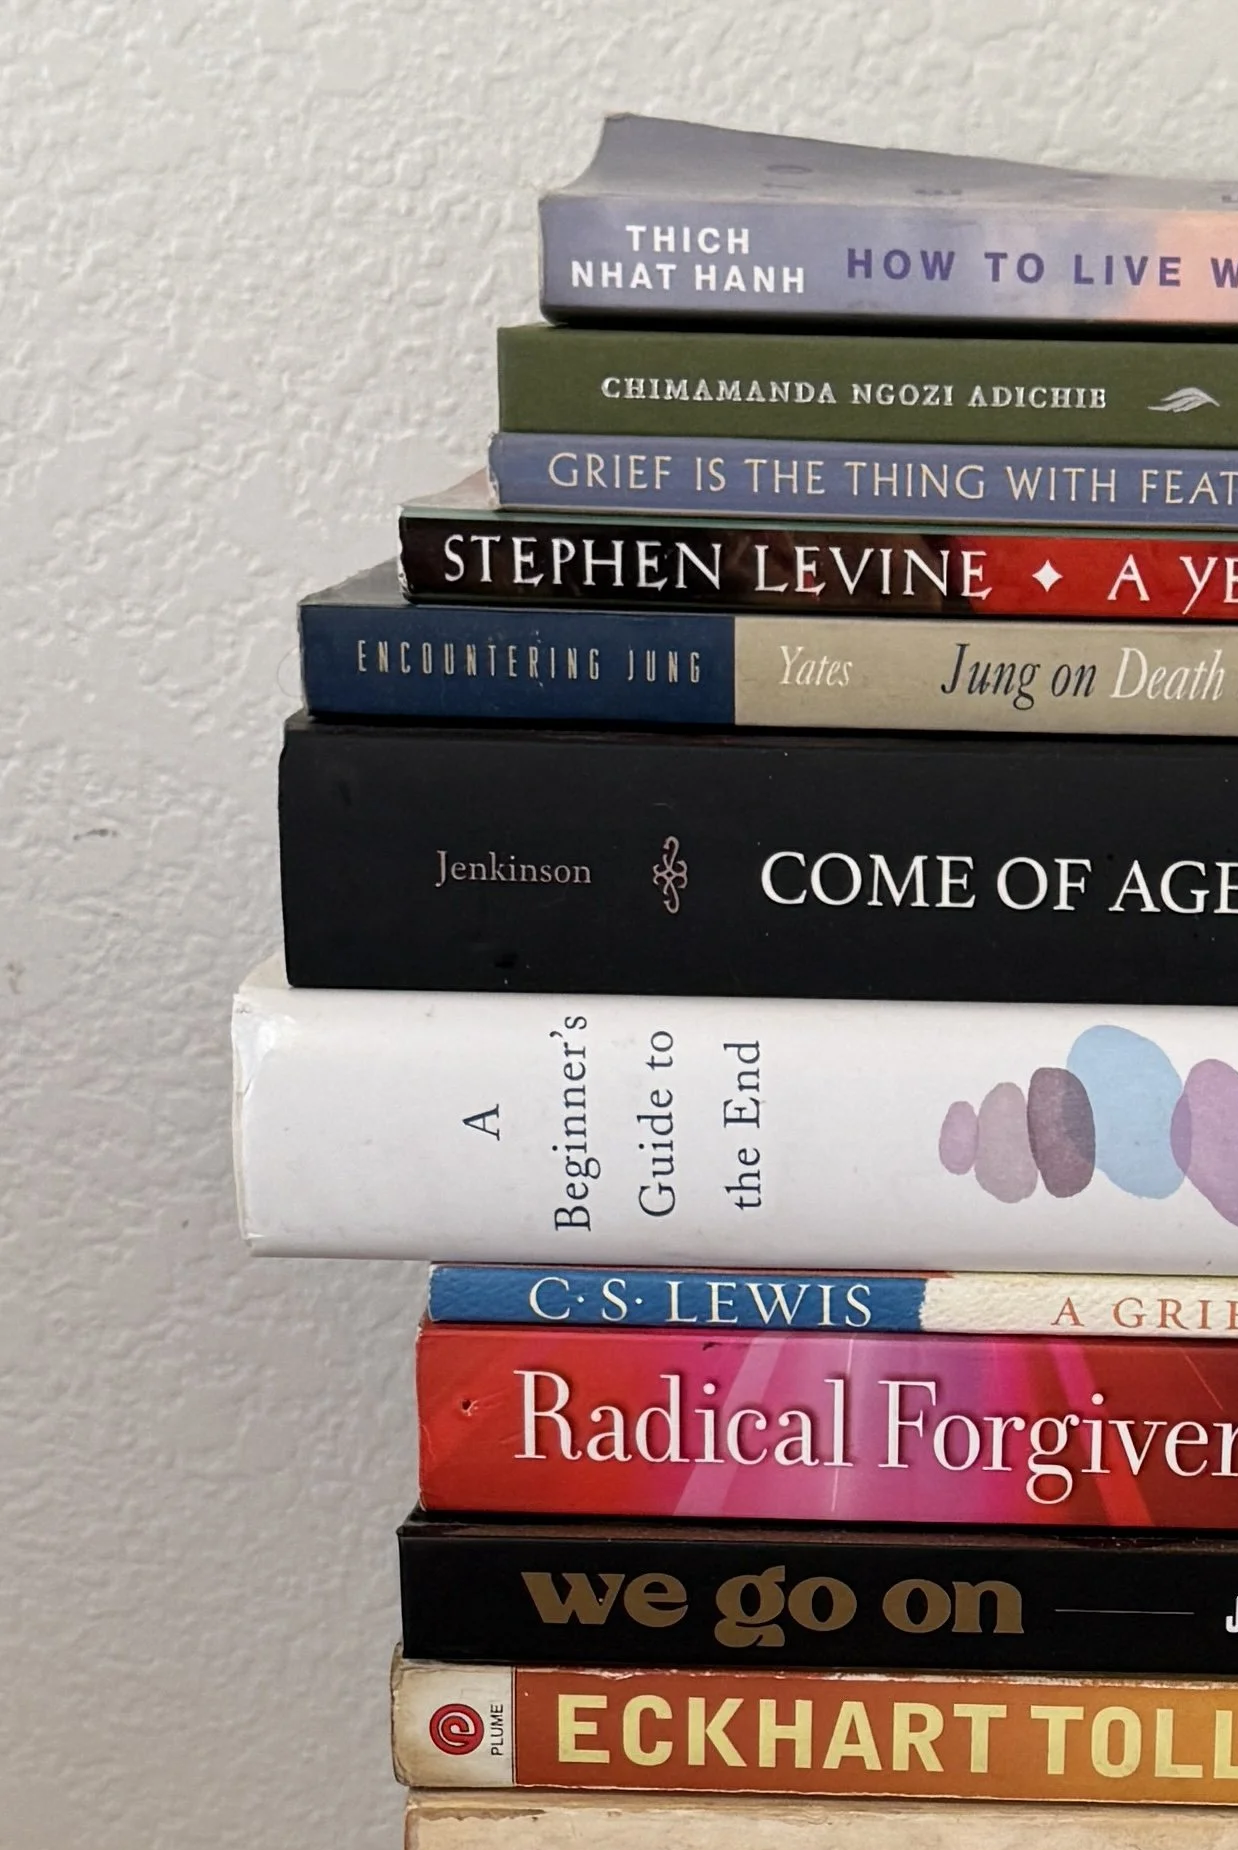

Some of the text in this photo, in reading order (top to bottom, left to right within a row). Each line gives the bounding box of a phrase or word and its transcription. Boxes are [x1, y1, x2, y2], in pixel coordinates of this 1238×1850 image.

[626, 225, 749, 253] THICH
[572, 262, 804, 293] NHAT HANH
[847, 249, 955, 280] HOW
[984, 252, 1045, 283] TO
[1074, 255, 1181, 286] LIVE
[601, 377, 1106, 410] CHIMAMANDA NGOZI ADICHIE
[549, 452, 671, 491] GRIEF
[696, 457, 725, 493] IS
[744, 459, 824, 495] THE
[844, 462, 985, 500] THING
[1005, 467, 1116, 502] WITH
[357, 639, 701, 684] ENCOUNTERING JUNG
[778, 645, 853, 690] Yates
[941, 642, 1041, 709] Jung
[1050, 662, 1097, 698] on
[1111, 647, 1226, 700] Death
[435, 850, 592, 888] Jenkinson
[761, 852, 976, 909] COME
[996, 857, 1093, 912] OF
[462, 1103, 500, 1140] A
[550, 1015, 601, 1232] Beginner's
[638, 1030, 676, 1217] Guide to
[723, 1040, 761, 1210] the End
[512, 1368, 852, 1469] Radical
[521, 1565, 1024, 1648] we go on
[491, 1703, 503, 1756] PLUME
[557, 1695, 1008, 1774] ECKHART
